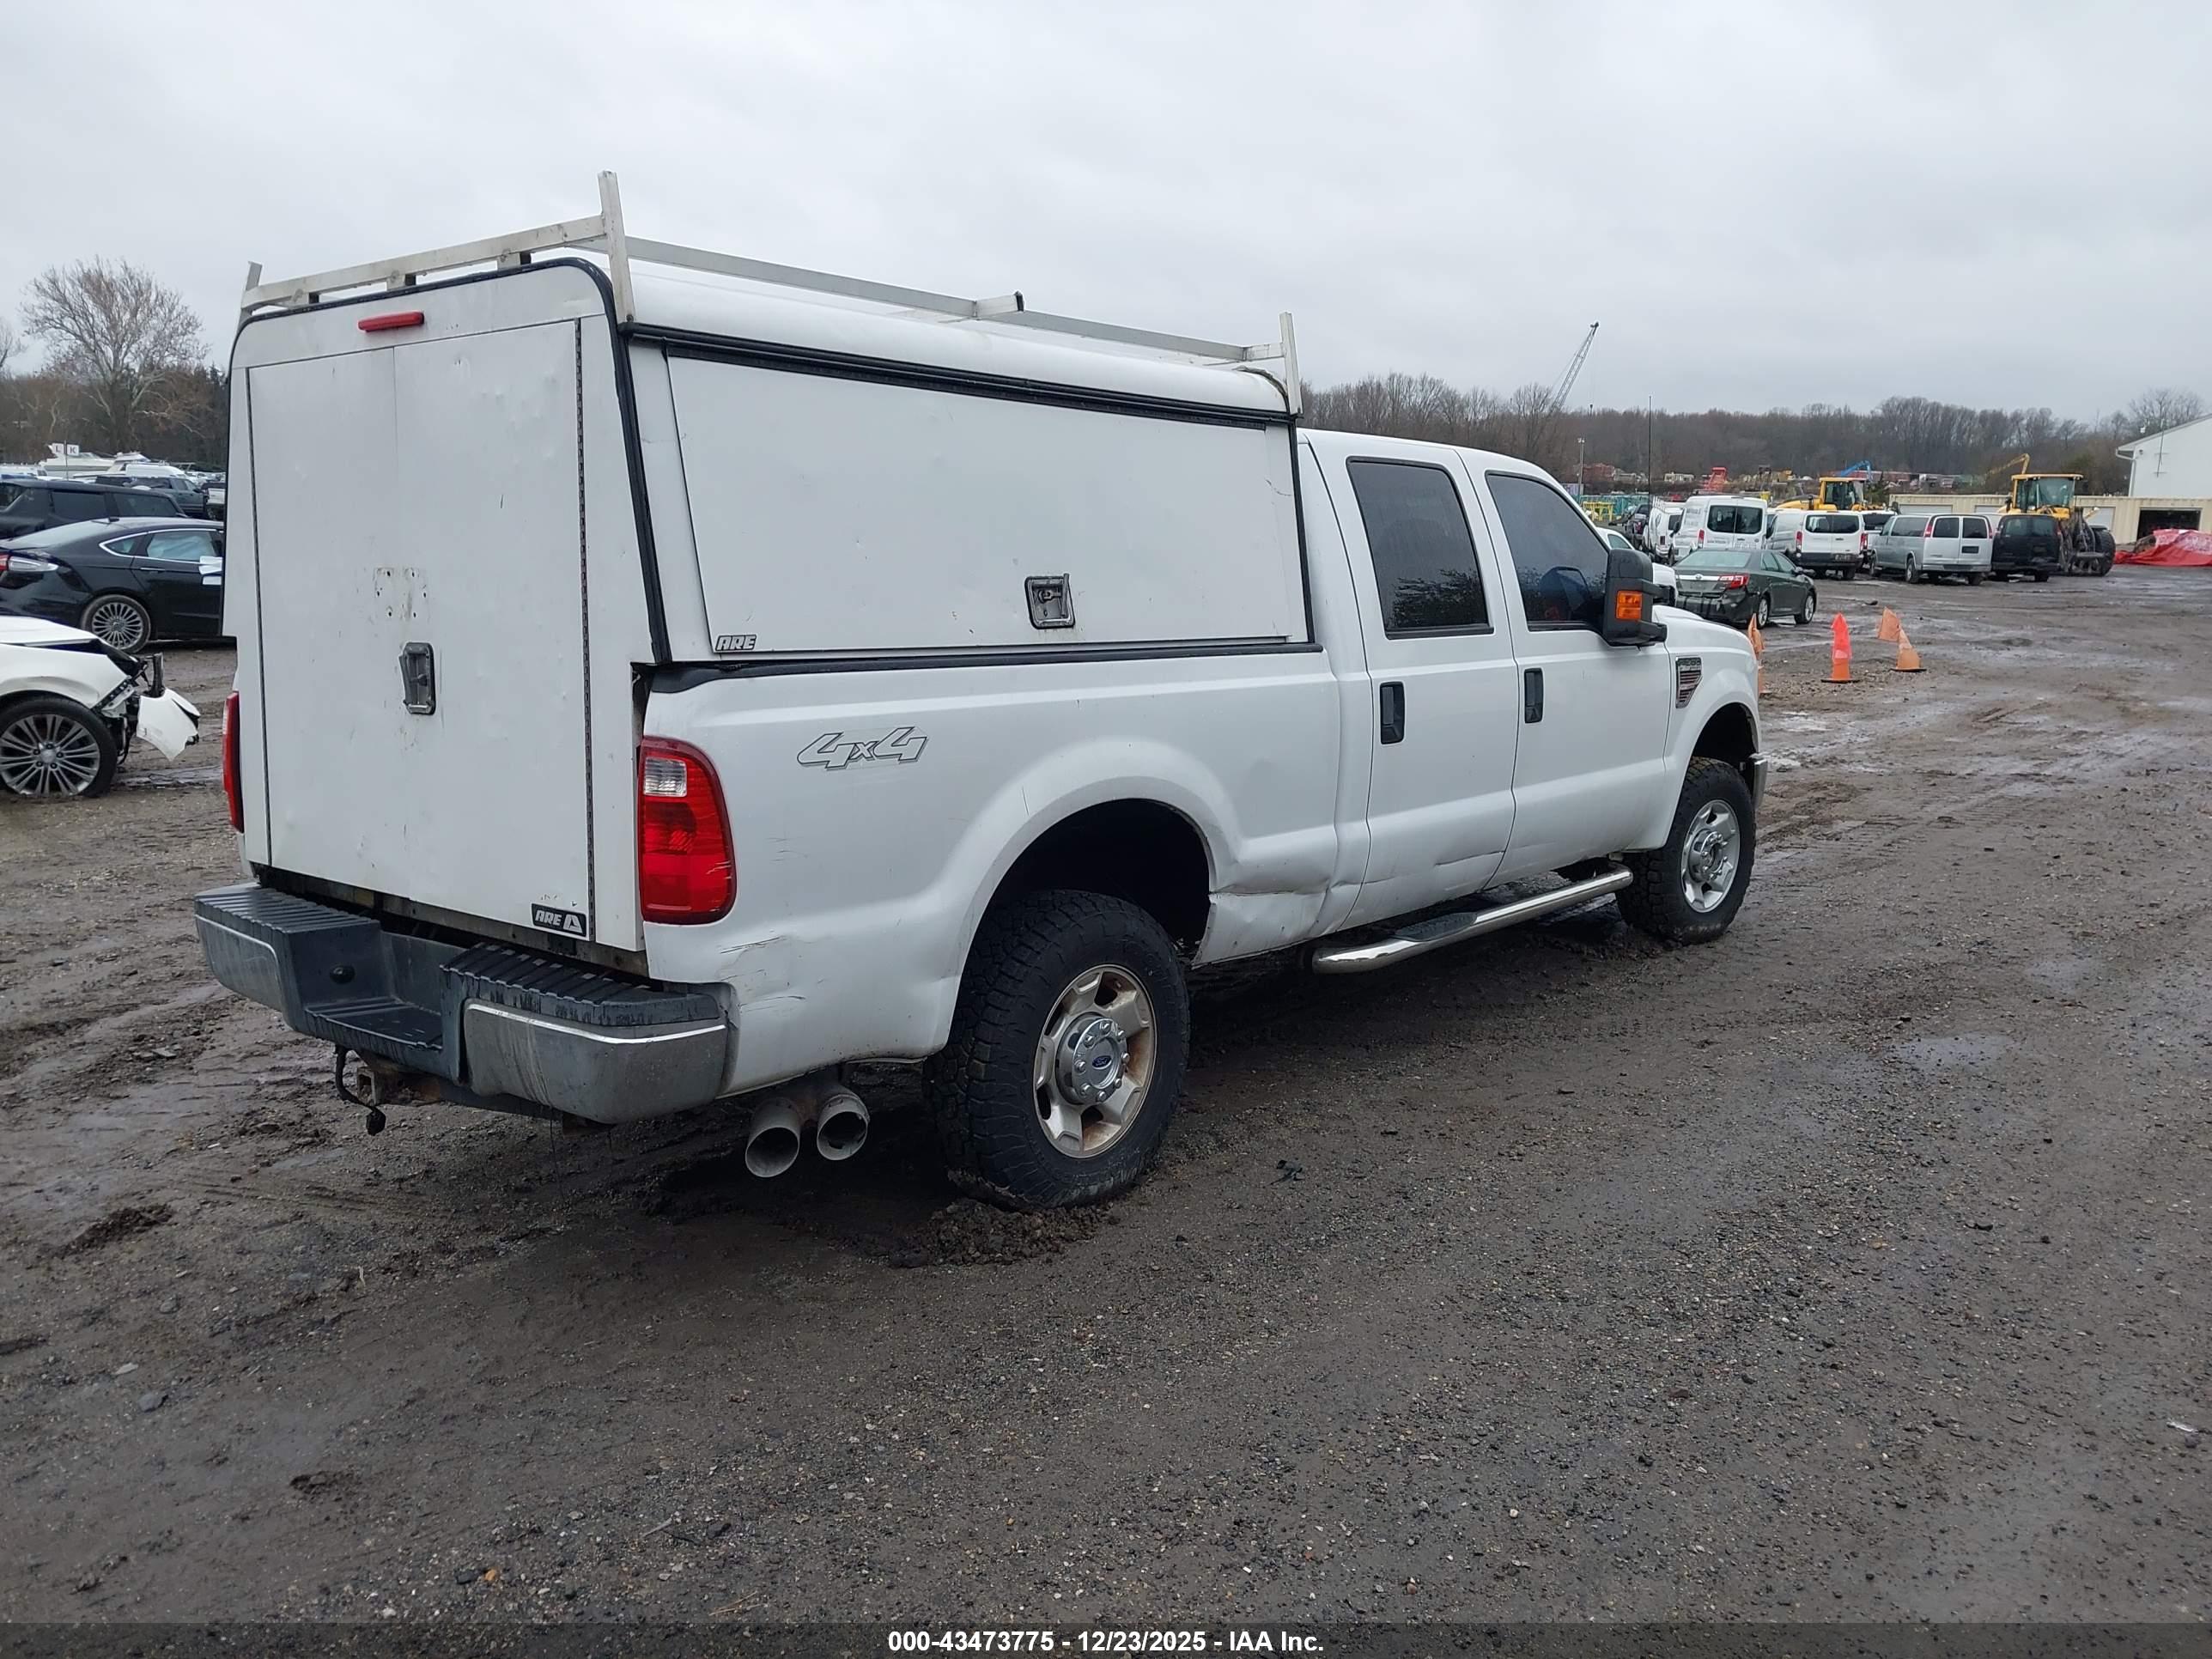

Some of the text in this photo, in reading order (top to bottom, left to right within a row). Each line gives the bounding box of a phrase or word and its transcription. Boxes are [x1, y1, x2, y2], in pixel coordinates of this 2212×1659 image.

[715, 635, 757, 651] ARE
[797, 726, 929, 771] 4x4
[535, 909, 562, 927] ARE
